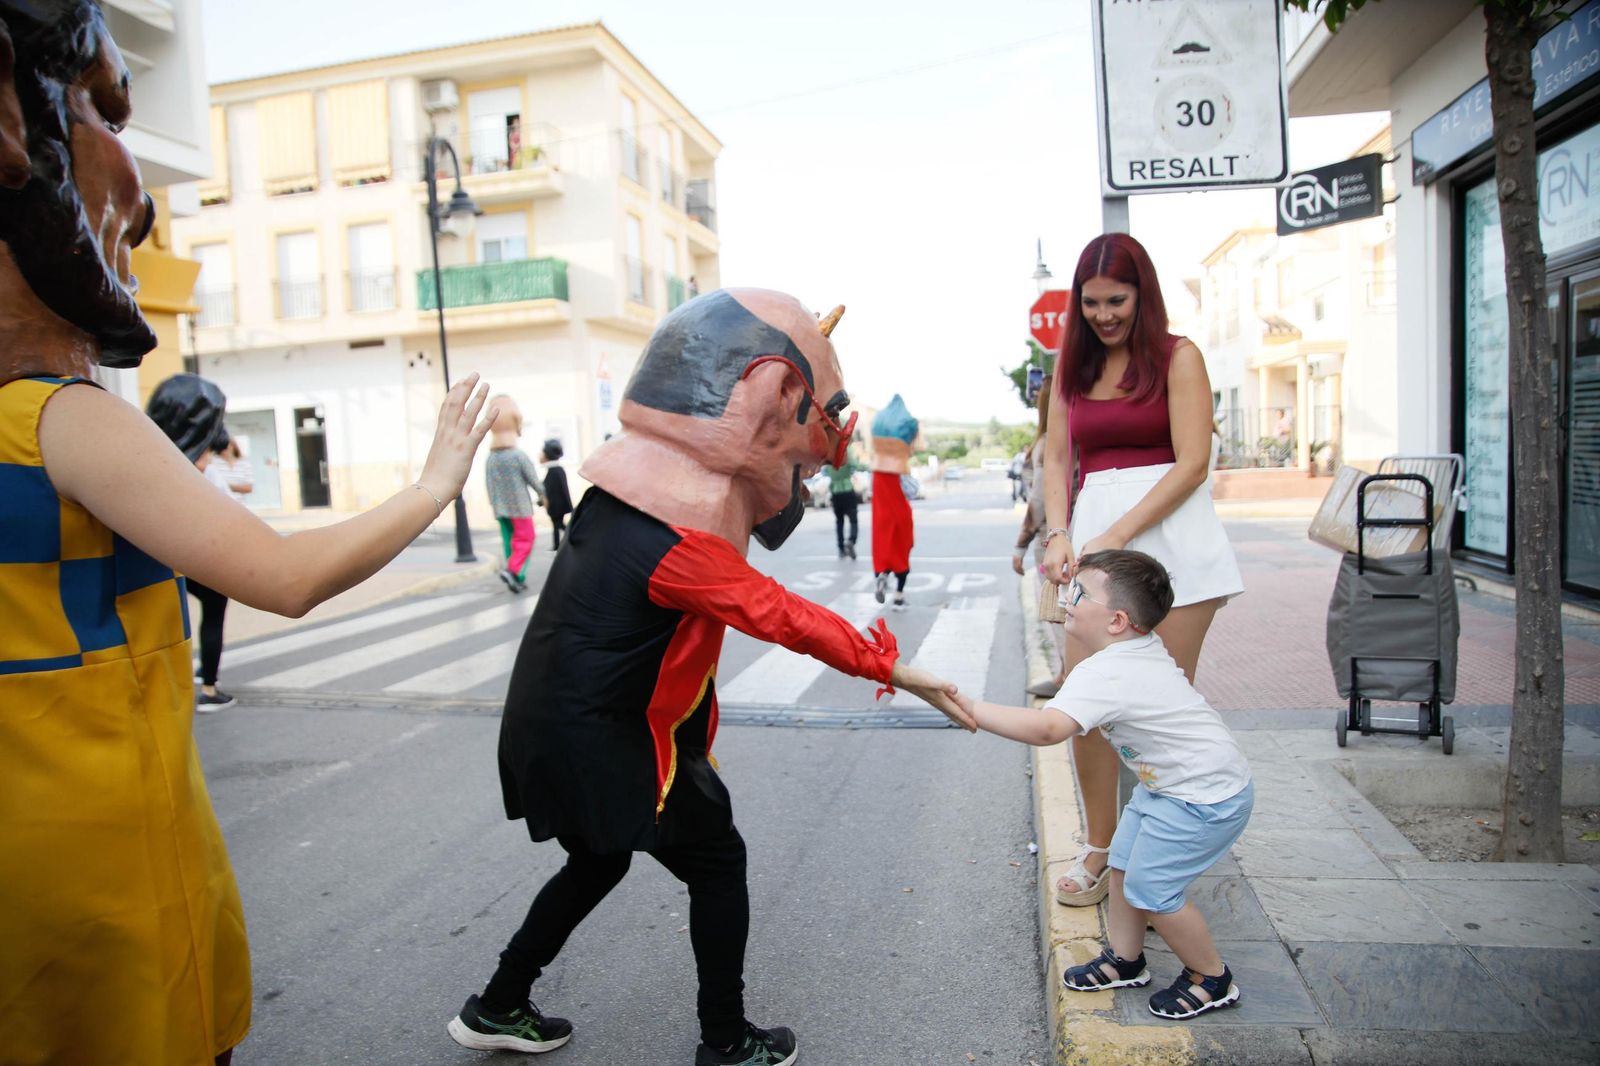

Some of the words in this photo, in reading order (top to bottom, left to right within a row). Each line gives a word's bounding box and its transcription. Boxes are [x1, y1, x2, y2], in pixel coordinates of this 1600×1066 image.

[1441, 87, 1490, 135] REYE
[1532, 6, 1600, 69] AVAR
[1176, 99, 1216, 127] 30
[1129, 156, 1240, 181] RESALT
[1031, 311, 1068, 330] STO
